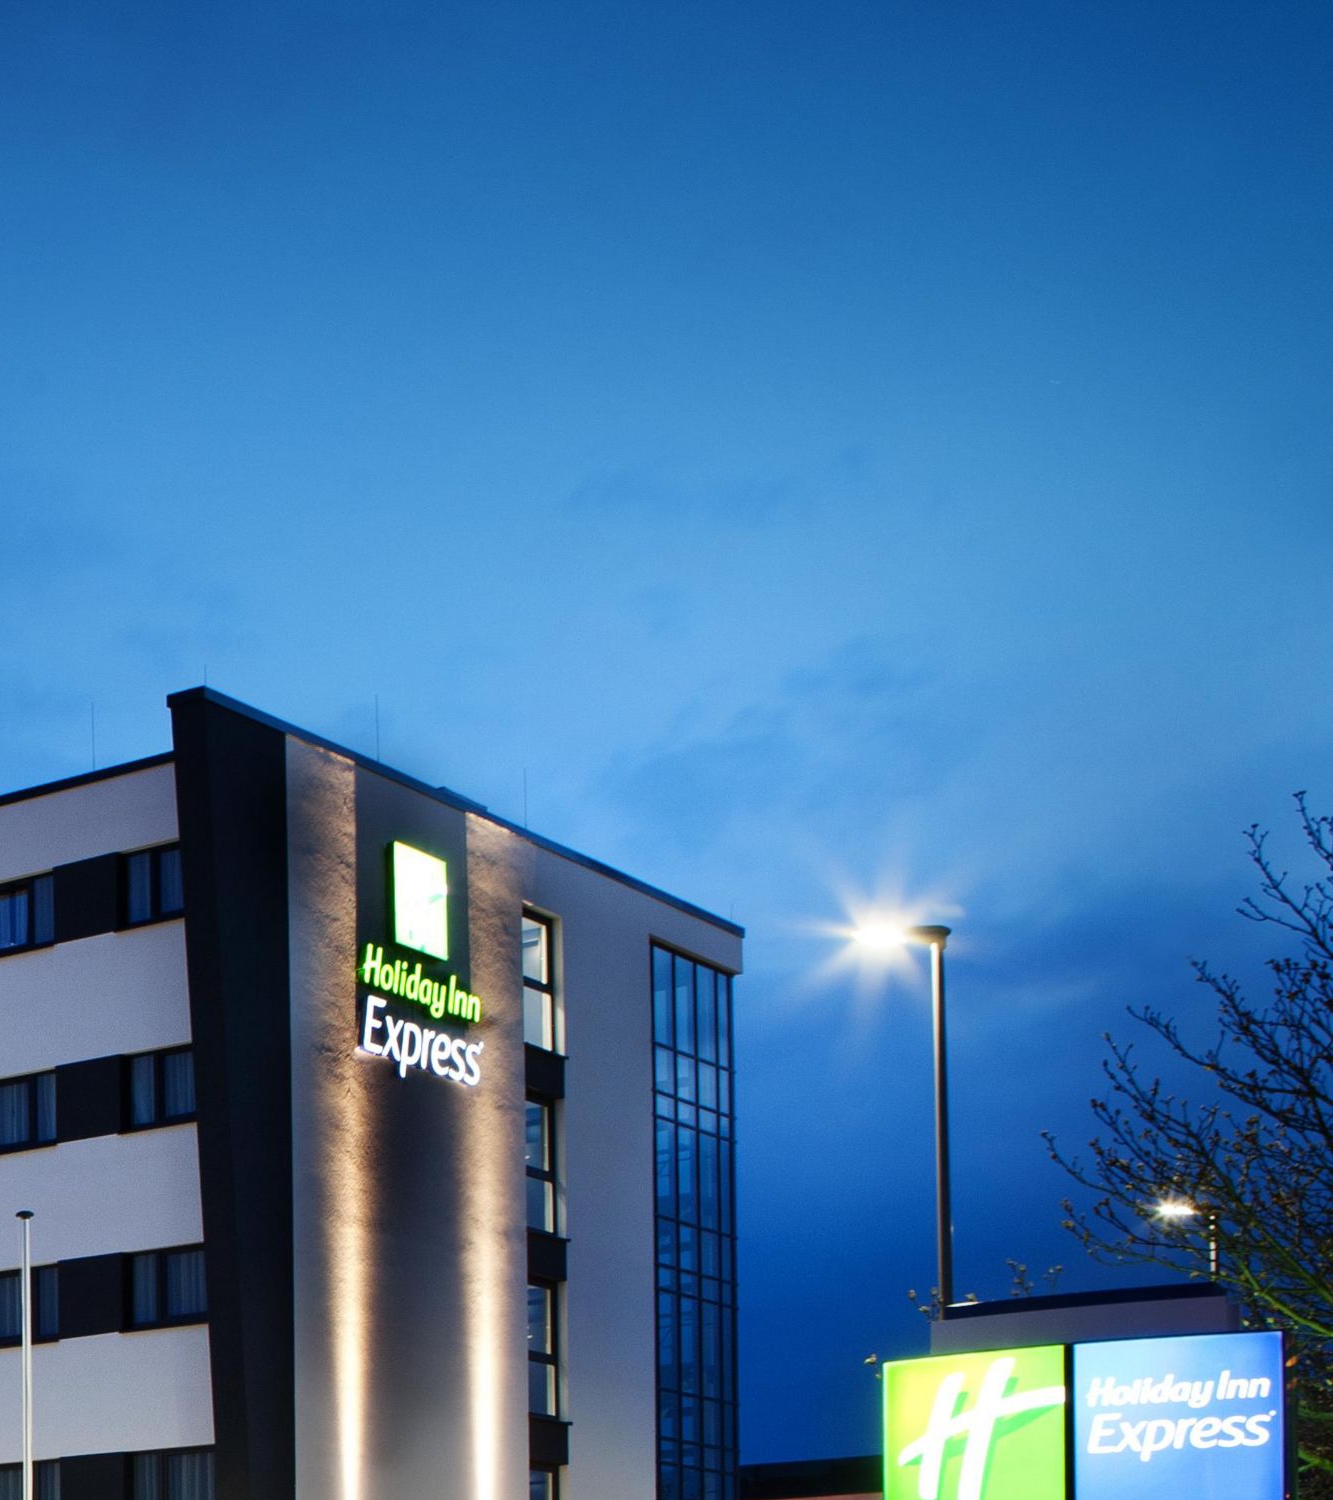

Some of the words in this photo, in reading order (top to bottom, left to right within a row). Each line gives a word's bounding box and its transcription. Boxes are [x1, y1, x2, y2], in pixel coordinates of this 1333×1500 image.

[363, 943, 446, 1018] Holiday
[447, 975, 481, 1022] Inn
[363, 995, 482, 1087] Express
[1086, 1374, 1215, 1409] Holiday
[1216, 1370, 1271, 1400] Inn
[1087, 1412, 1272, 1463] Express
